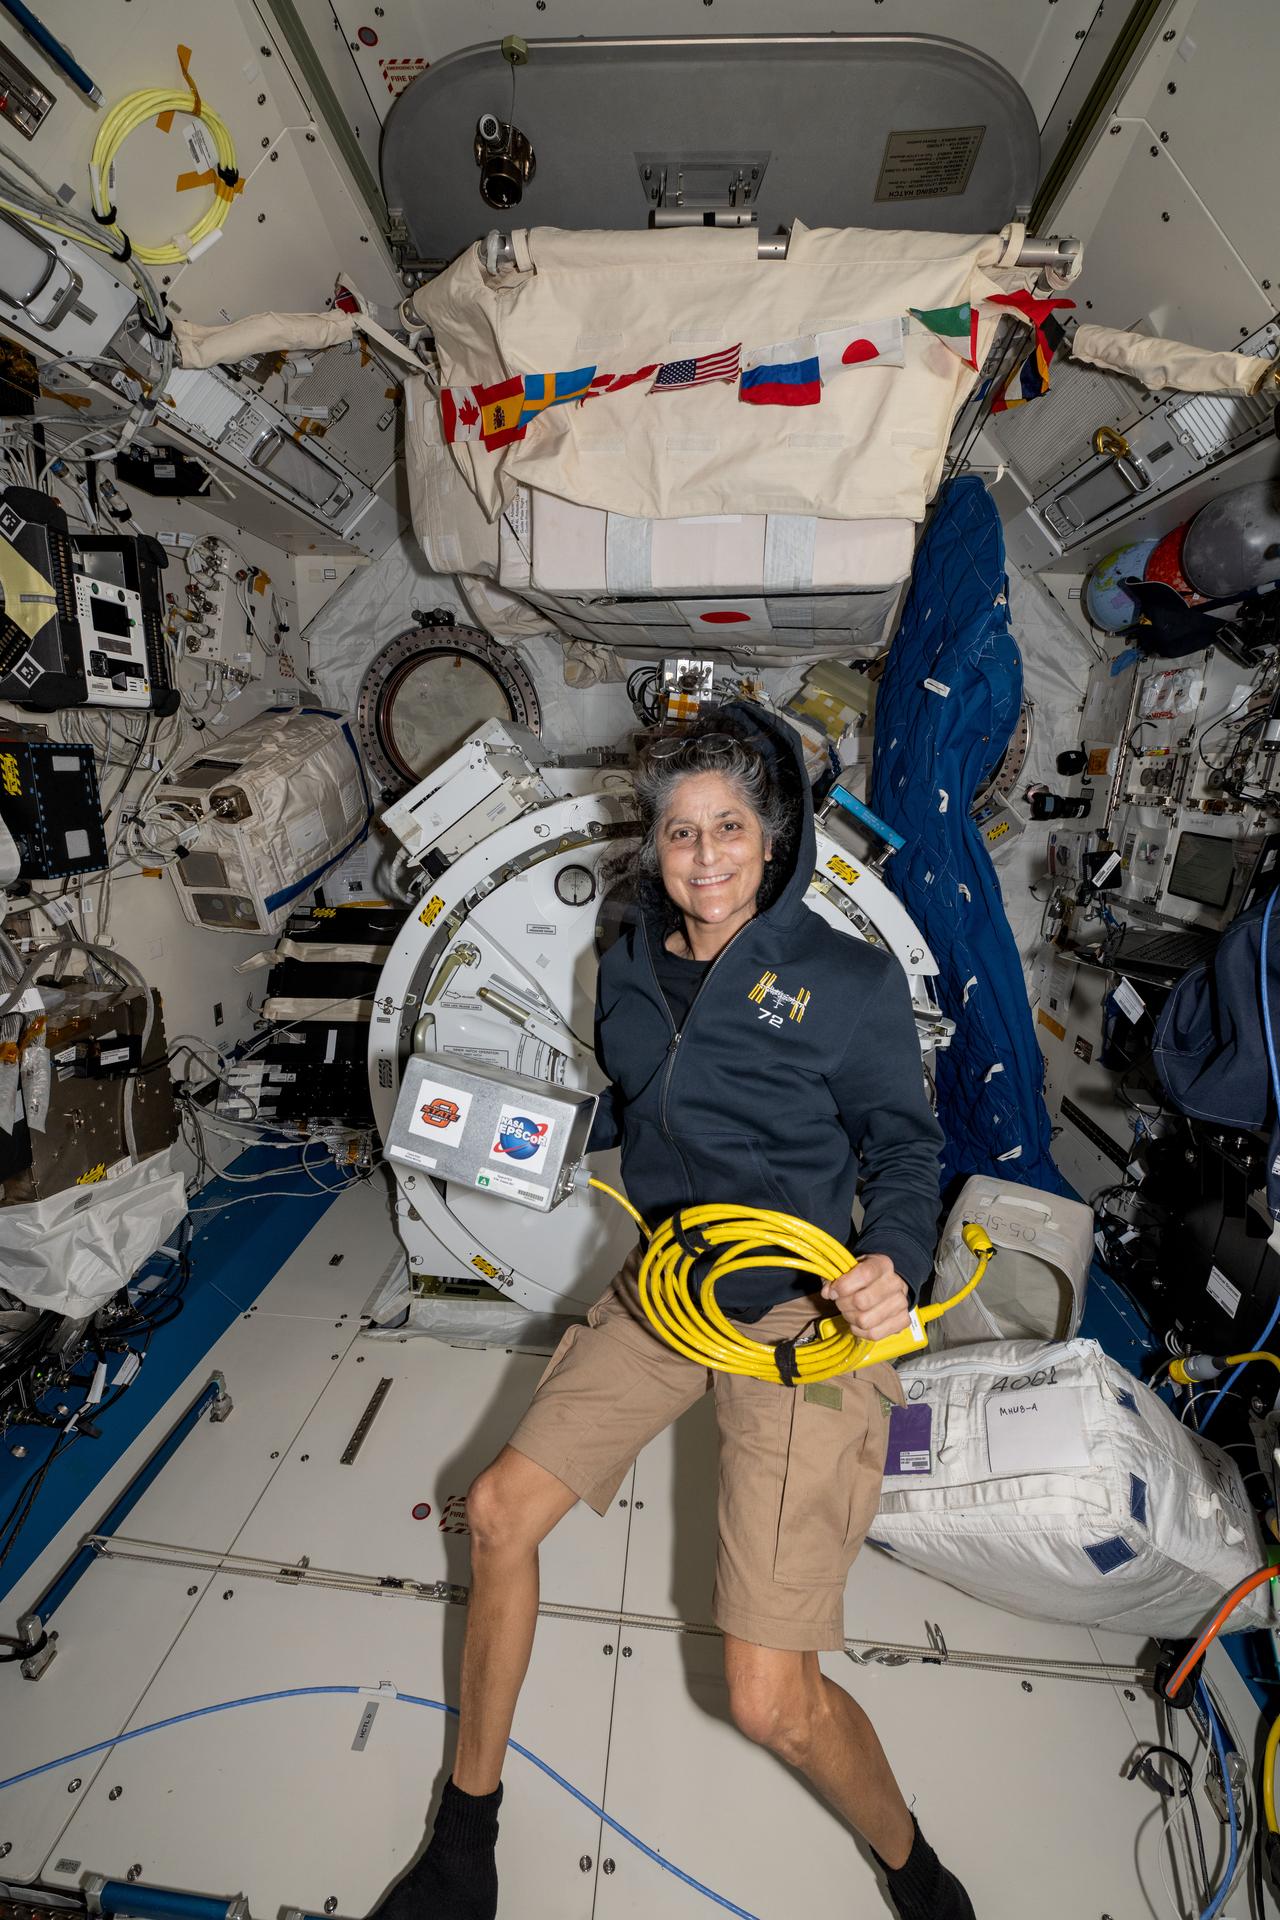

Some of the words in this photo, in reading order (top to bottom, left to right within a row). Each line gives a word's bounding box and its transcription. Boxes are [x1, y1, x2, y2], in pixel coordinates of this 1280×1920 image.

[758, 1007, 784, 1029] 72
[421, 1104, 460, 1122] STATE
[501, 1116, 525, 1130] NASA
[500, 1123, 548, 1147] EPSCoR
[449, 1510, 465, 1519] FIRE
